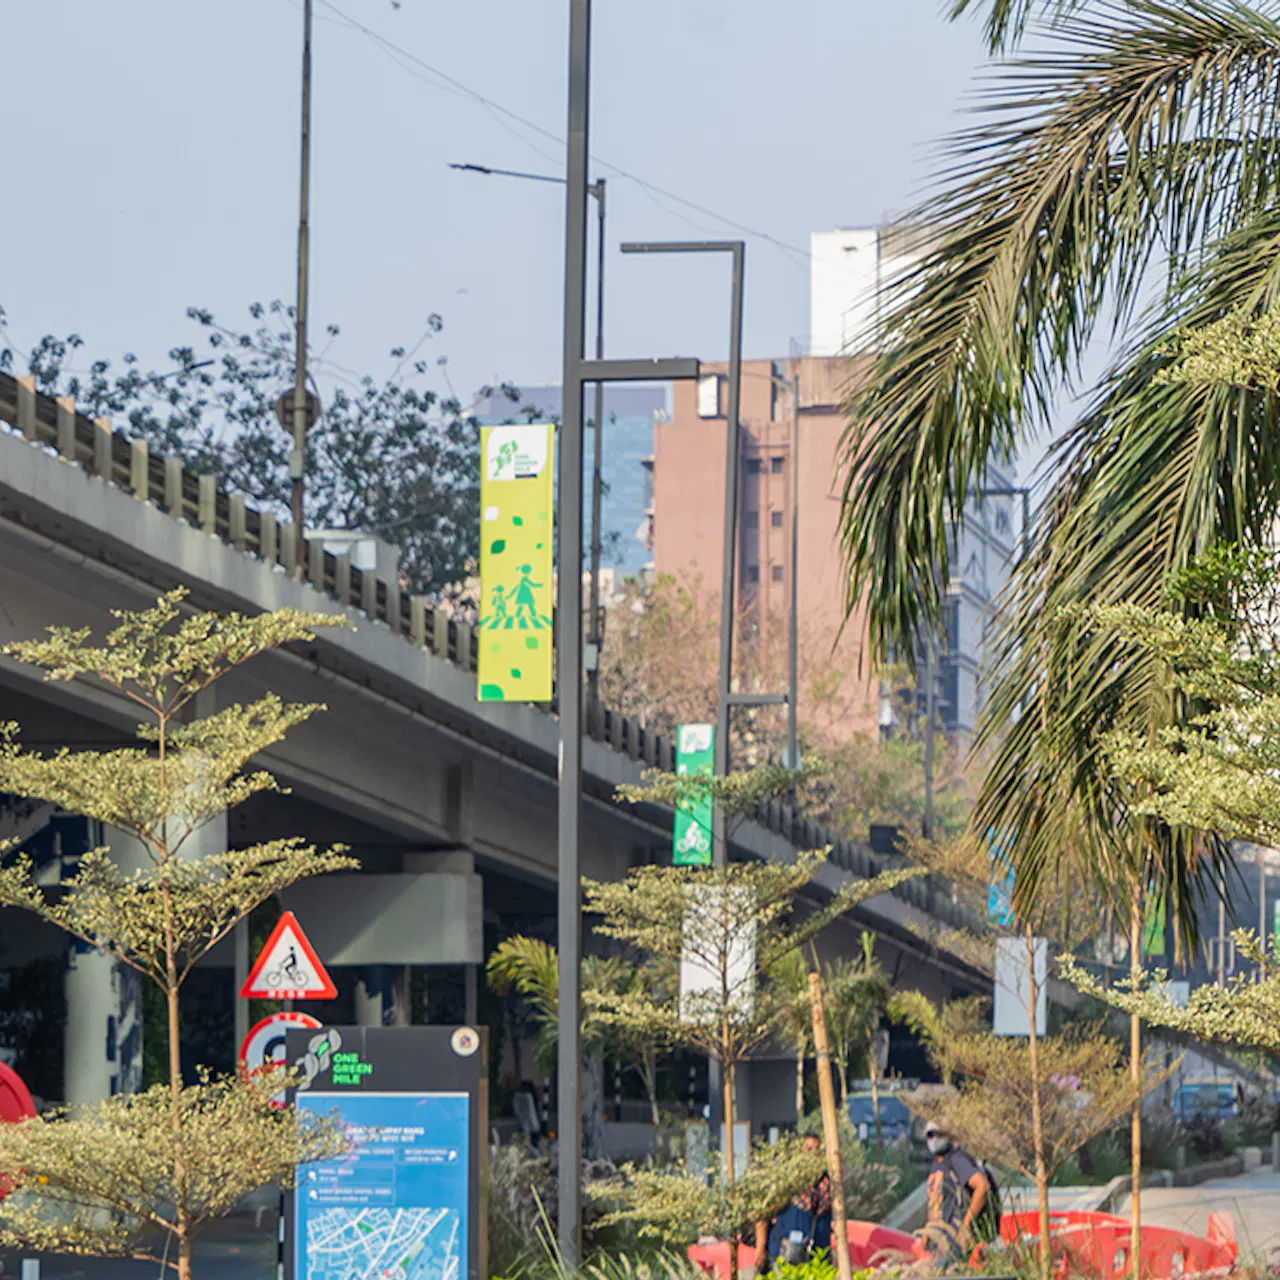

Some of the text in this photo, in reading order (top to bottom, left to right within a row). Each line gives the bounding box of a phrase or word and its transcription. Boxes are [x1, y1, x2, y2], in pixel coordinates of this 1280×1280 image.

[332, 1052, 359, 1063] ONE
[332, 1062, 373, 1075] GREEN
[332, 1073, 361, 1085] MILE
